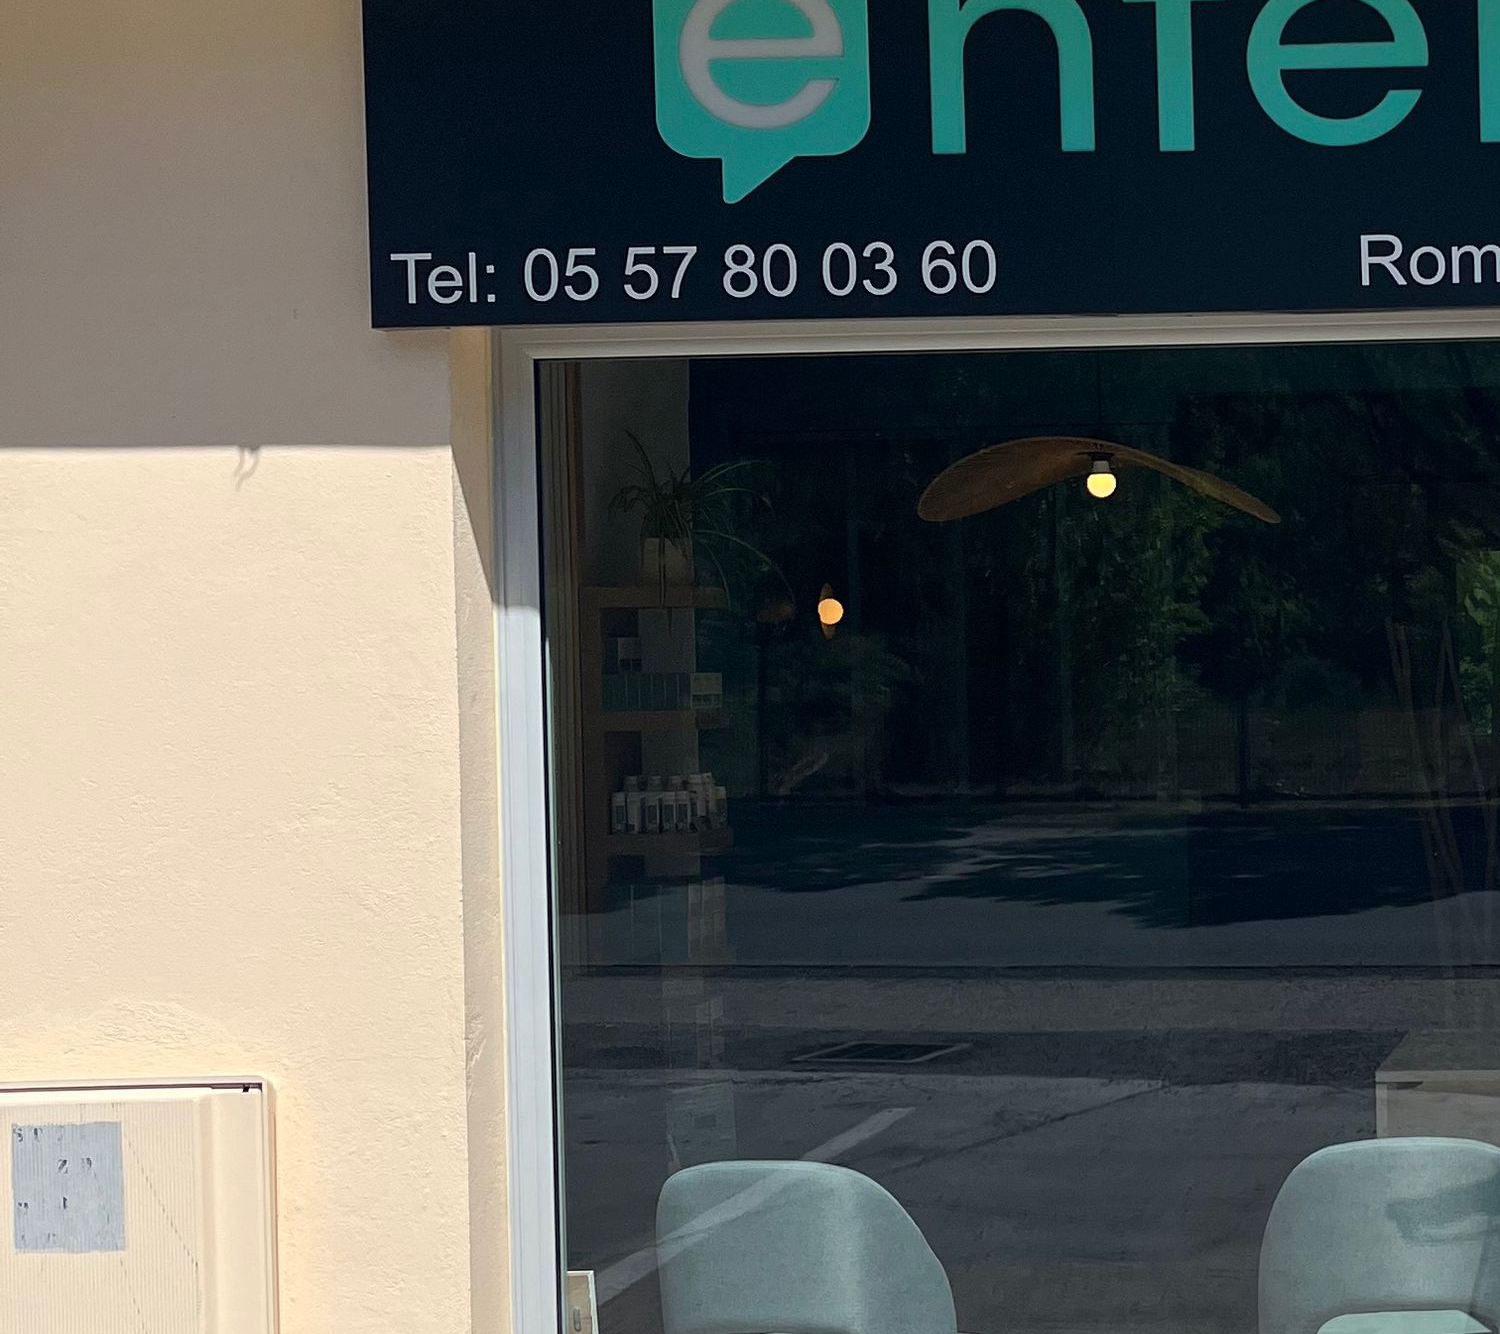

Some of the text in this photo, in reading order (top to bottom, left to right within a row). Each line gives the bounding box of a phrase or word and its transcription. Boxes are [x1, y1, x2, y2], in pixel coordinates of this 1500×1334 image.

[390, 239, 997, 304] Tel: 05 57 80 03 60
